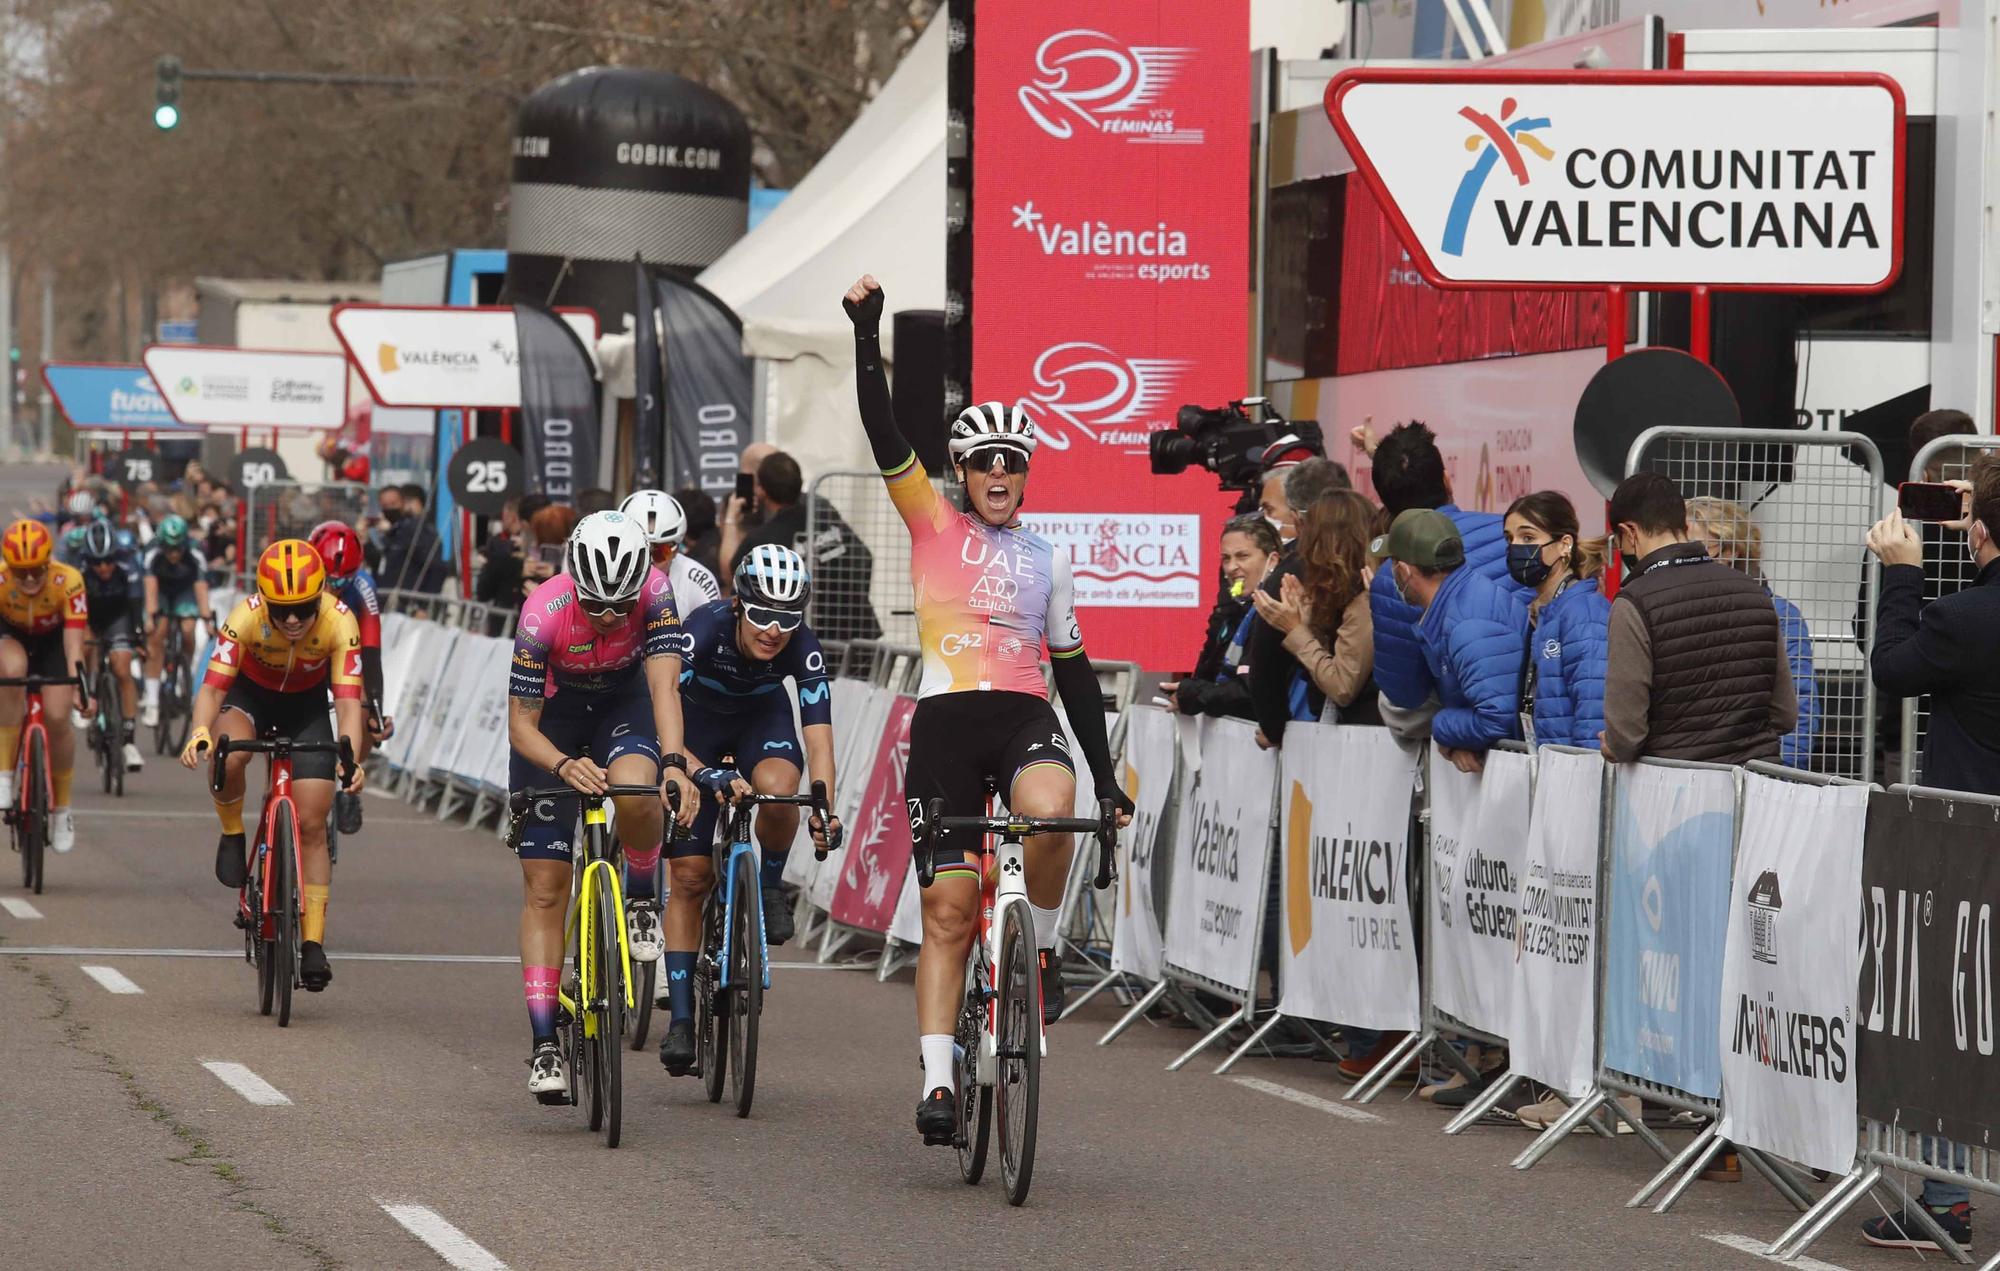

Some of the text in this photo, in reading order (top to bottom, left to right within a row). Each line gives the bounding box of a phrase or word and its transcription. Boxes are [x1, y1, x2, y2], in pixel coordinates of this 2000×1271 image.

[1102, 117, 1174, 133] FÉMINAS
[616, 142, 721, 170] GOBIK.COM
[1564, 148, 1876, 190] COMUNITAT
[1494, 199, 1879, 249] VALENCIANA
[1037, 221, 1188, 256] València
[1137, 262, 1211, 284] esports
[124, 459, 152, 481] 75
[241, 461, 276, 488] 50
[466, 460, 508, 493] 25
[1161, 522, 1190, 537] DE
[961, 535, 1034, 578] UAE
[1054, 541, 1190, 568] LÈNCIA
[940, 633, 982, 657] G42
